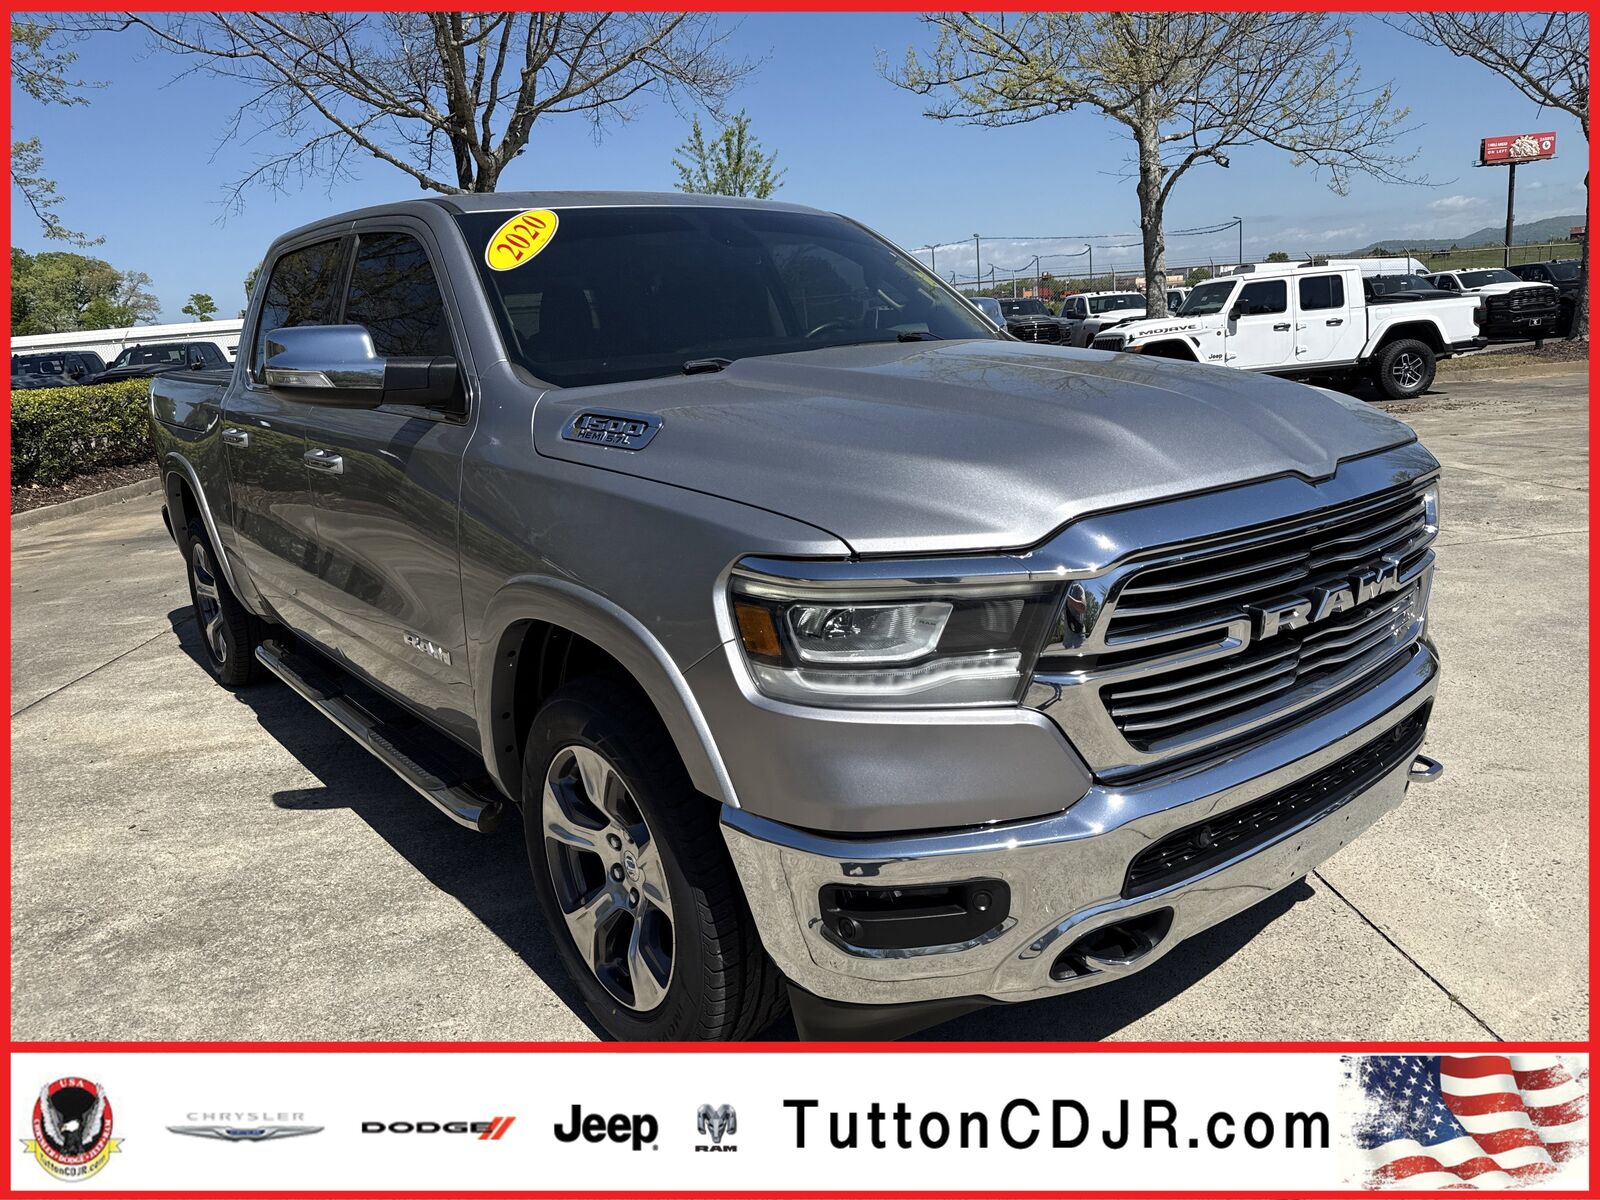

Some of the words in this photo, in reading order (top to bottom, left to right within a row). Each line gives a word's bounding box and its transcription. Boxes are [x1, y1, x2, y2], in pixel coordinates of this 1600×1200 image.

[497, 216, 546, 261] 2020
[1139, 324, 1197, 336] MOJAVE
[577, 430, 605, 442] HEMI
[605, 434, 630, 445] 5.7L
[581, 416, 645, 436] 1500
[1250, 554, 1401, 641] RAM
[403, 632, 452, 666] RAM
